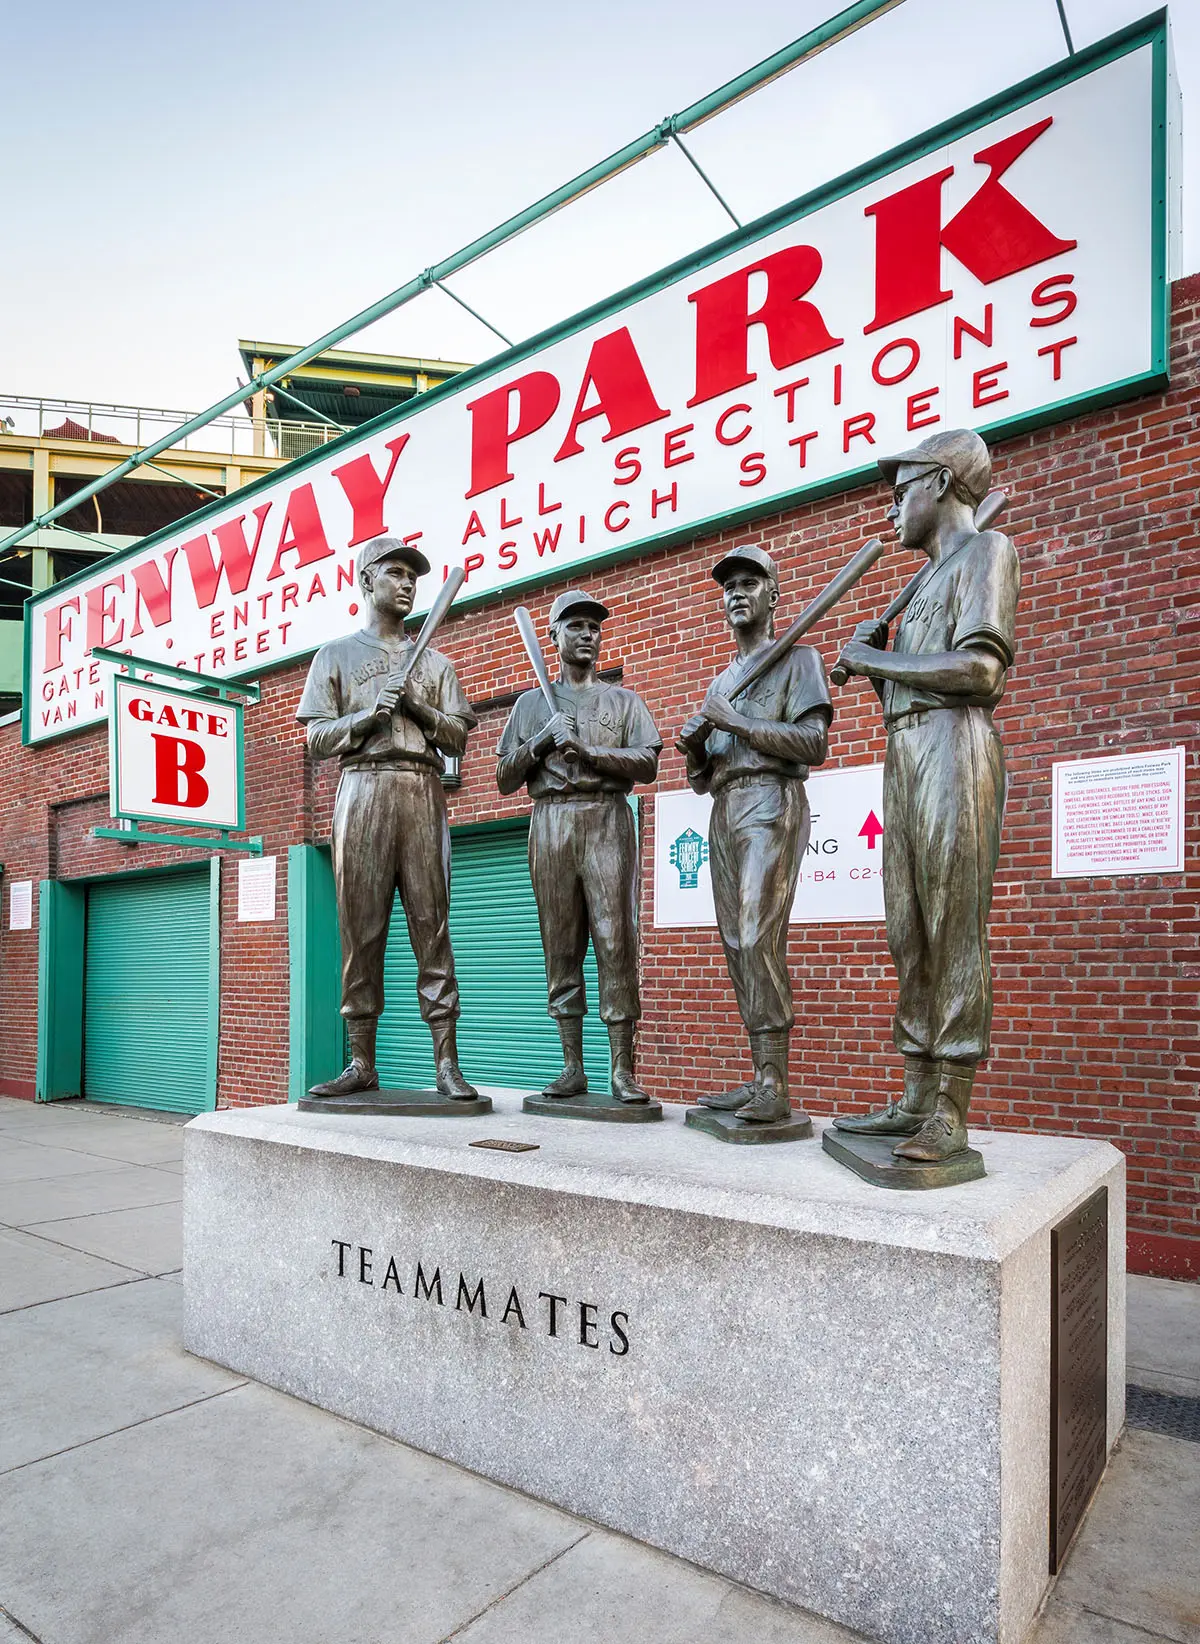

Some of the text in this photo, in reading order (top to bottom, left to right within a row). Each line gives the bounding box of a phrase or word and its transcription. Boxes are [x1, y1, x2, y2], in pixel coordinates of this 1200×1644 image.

[41, 699, 78, 727] VAN
[443, 482, 678, 584] IPSWICH
[739, 336, 1078, 486] STREET
[42, 661, 100, 701] GATE
[210, 531, 424, 638] ENTRAN
[462, 482, 562, 545] ALL
[613, 274, 1078, 485] SECTIONS
[43, 116, 1077, 672] FENWAY PARK
[128, 698, 228, 808] GATE B
[331, 1239, 630, 1356] TEAMMATES
